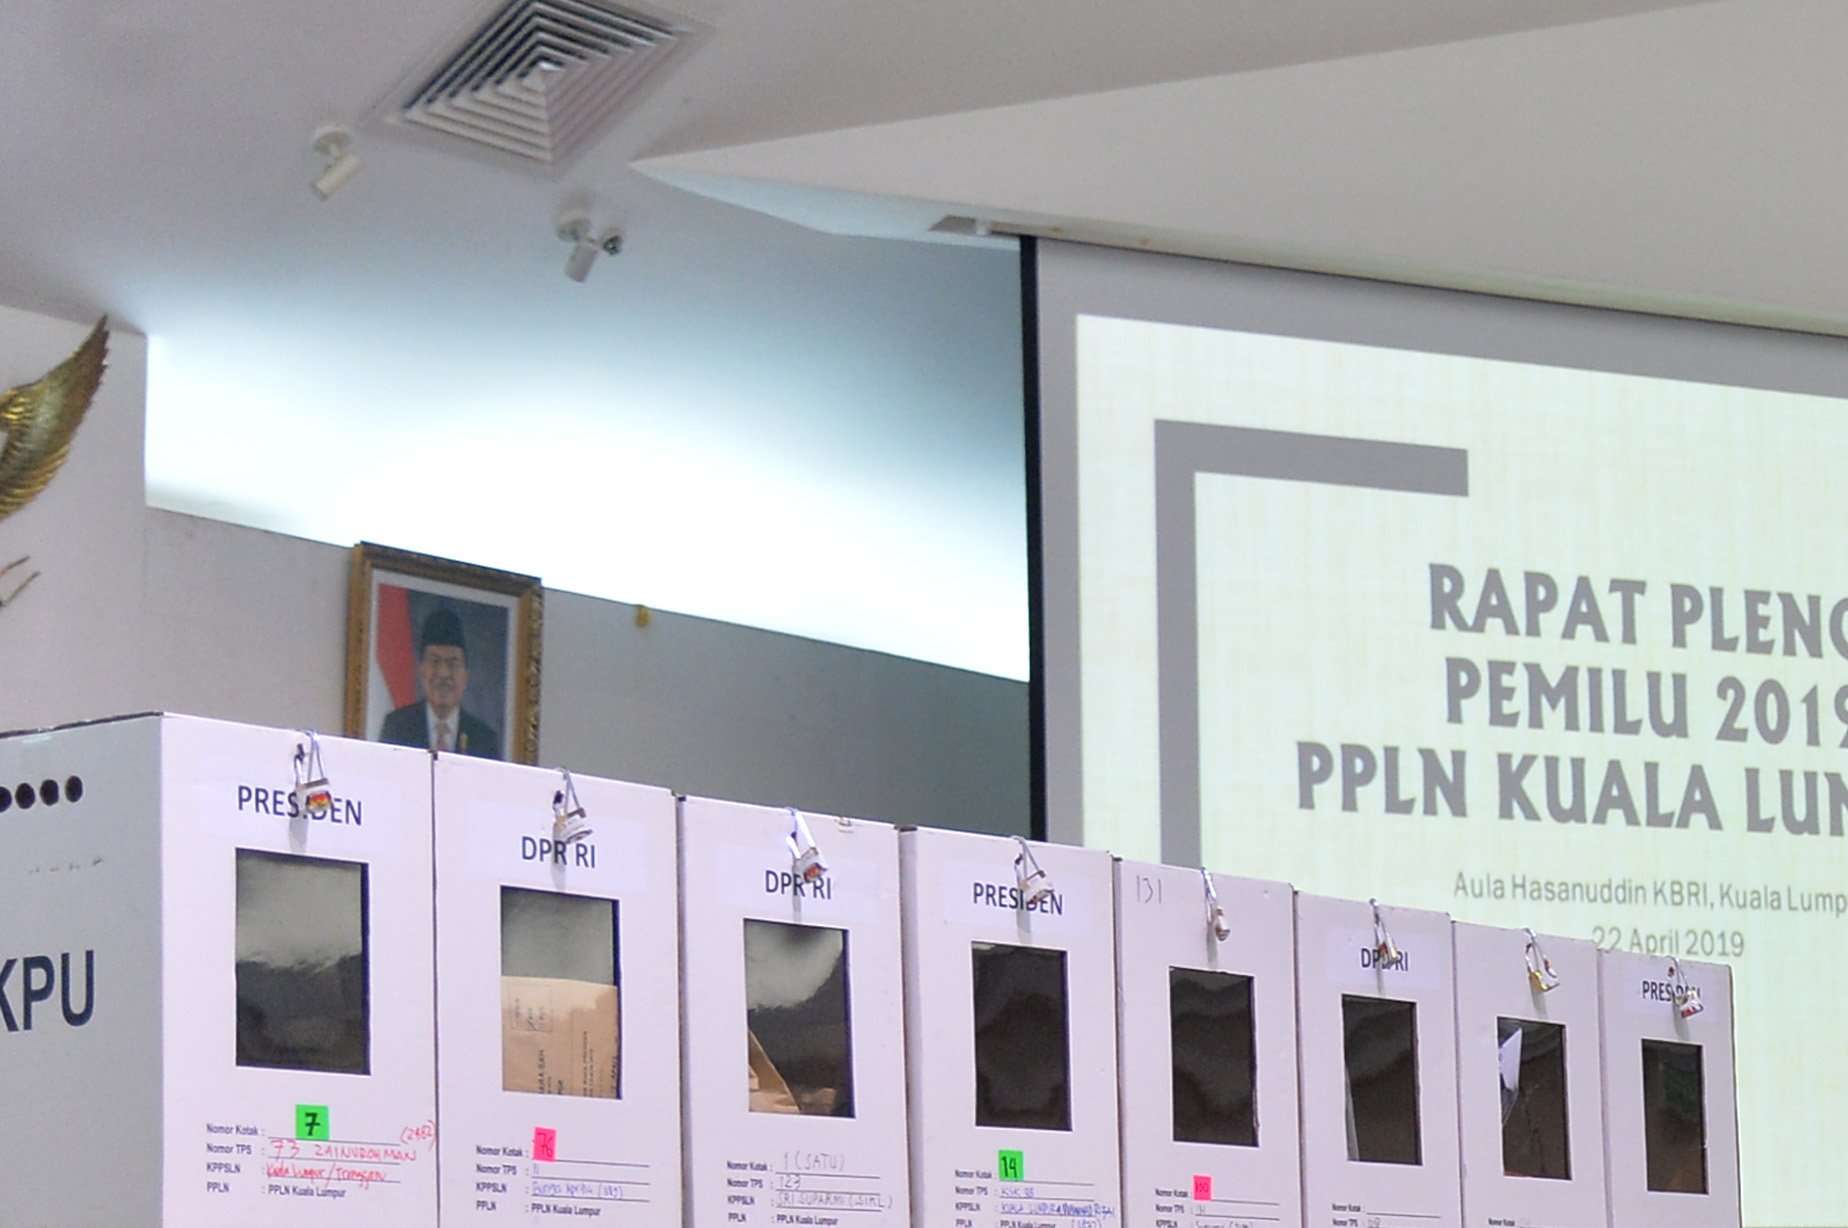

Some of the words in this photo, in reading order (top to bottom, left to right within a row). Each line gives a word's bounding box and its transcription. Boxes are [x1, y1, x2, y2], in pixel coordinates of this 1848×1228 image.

[1429, 563, 1648, 645] RAPAT
[1446, 656, 1690, 740] PEMILU
[1296, 741, 1468, 819] PPLN
[1496, 752, 1724, 831] KUALA
[238, 785, 362, 826] PRESEN
[521, 836, 567, 866] DPR
[575, 843, 597, 869] RI
[764, 869, 805, 898] DPR
[812, 876, 832, 901] RI
[1454, 871, 1505, 899] Aula
[1511, 875, 1646, 906] Hasanuddin
[1653, 881, 1714, 911] KBRI,
[1720, 884, 1781, 911] Kuala
[1592, 926, 1621, 952] 22
[1629, 928, 1679, 954] April
[1685, 929, 1744, 957] 2019
[1361, 947, 1391, 969] DP
[206, 1123, 233, 1134] Nomor
[235, 1125, 258, 1136] Kotak
[304, 1112, 320, 1136] 7
[206, 1143, 233, 1154] Nomor
[235, 1144, 252, 1155] TPS
[476, 1145, 500, 1156] Nomor
[502, 1146, 523, 1157] Kotak
[206, 1162, 240, 1173] KPPSLN
[476, 1164, 500, 1174] Nomor
[502, 1164, 517, 1175] TPS
[1001, 1155, 1017, 1178] 14
[206, 1182, 230, 1193] PPLN
[268, 1184, 290, 1195] PPLN
[292, 1186, 314, 1197] Kuala
[316, 1187, 346, 1199] Lumpur
[476, 1201, 496, 1211] PPLN
[531, 1203, 551, 1213] PPLN
[552, 1204, 572, 1215] Kuala
[574, 1206, 601, 1217] Lumpur
